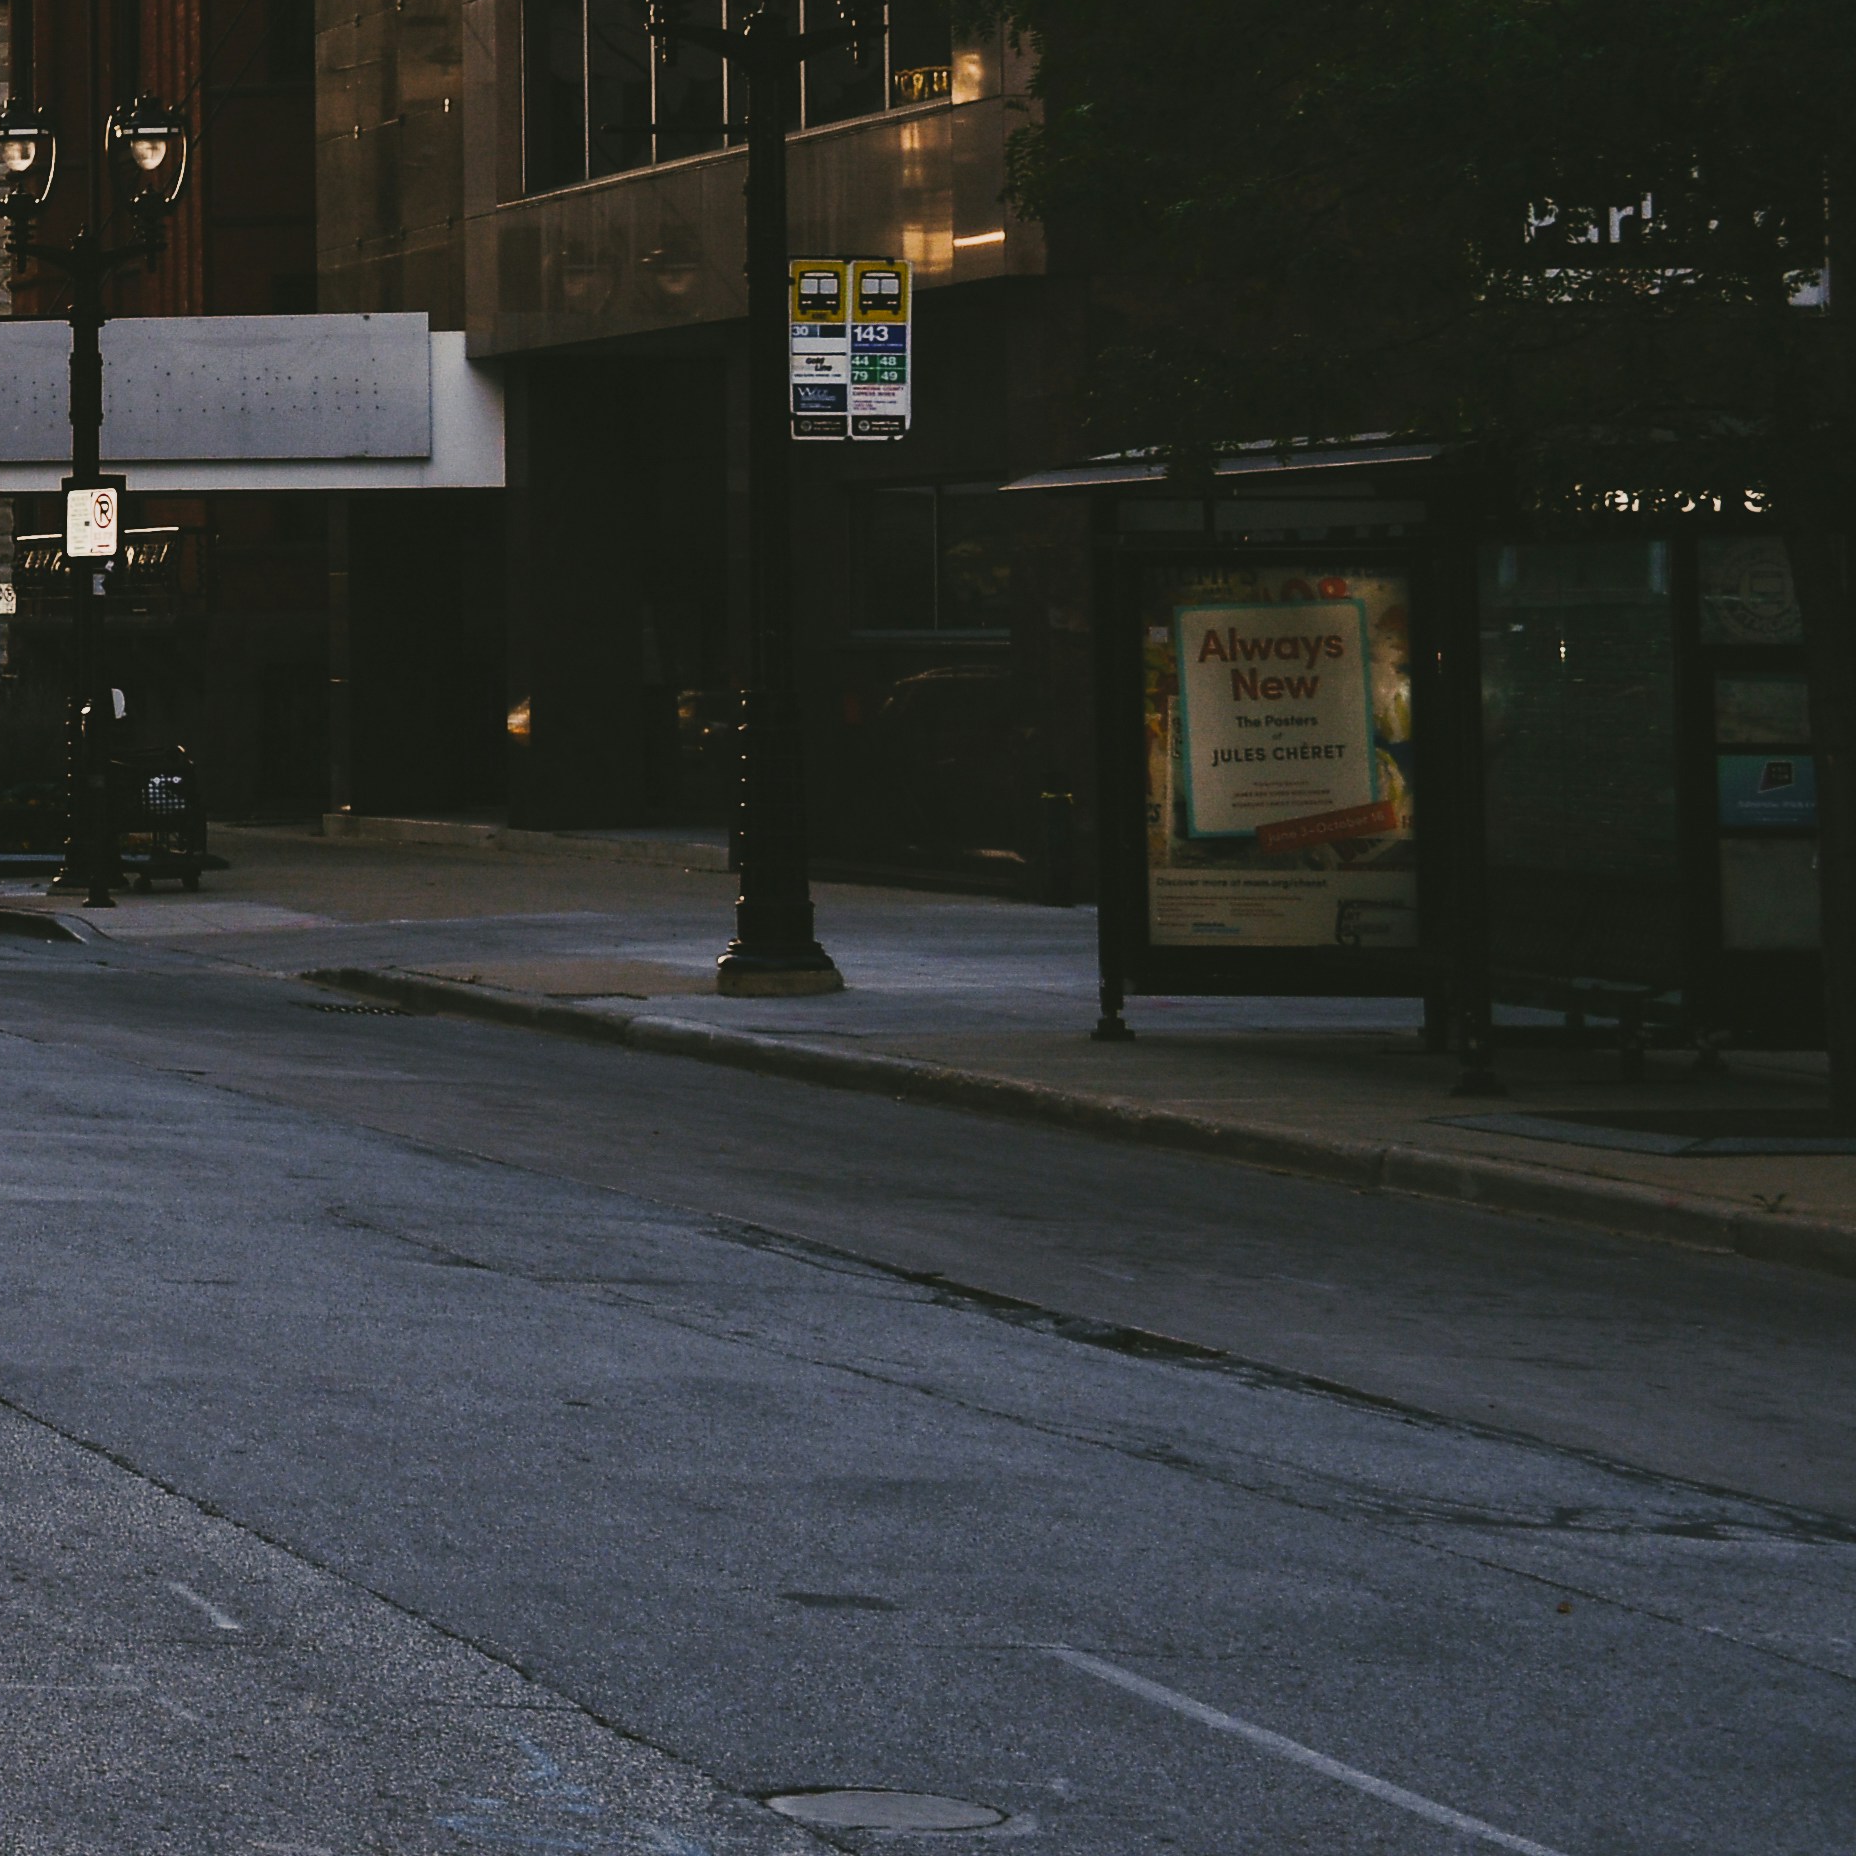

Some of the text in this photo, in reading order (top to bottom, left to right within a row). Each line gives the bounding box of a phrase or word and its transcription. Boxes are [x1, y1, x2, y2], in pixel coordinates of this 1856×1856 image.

[792, 326, 809, 336] 30
[853, 326, 889, 342] 143
[851, 356, 896, 366] 44 48
[853, 370, 868, 381] 79
[881, 370, 898, 381] 49
[1198, 628, 1344, 669] Always
[1231, 668, 1319, 701] New
[1236, 715, 1318, 728] The Posters
[1211, 747, 1265, 766] JULES
[1266, 831, 1297, 846] June
[1156, 877, 1199, 887] Discover
[1202, 879, 1227, 887] more
